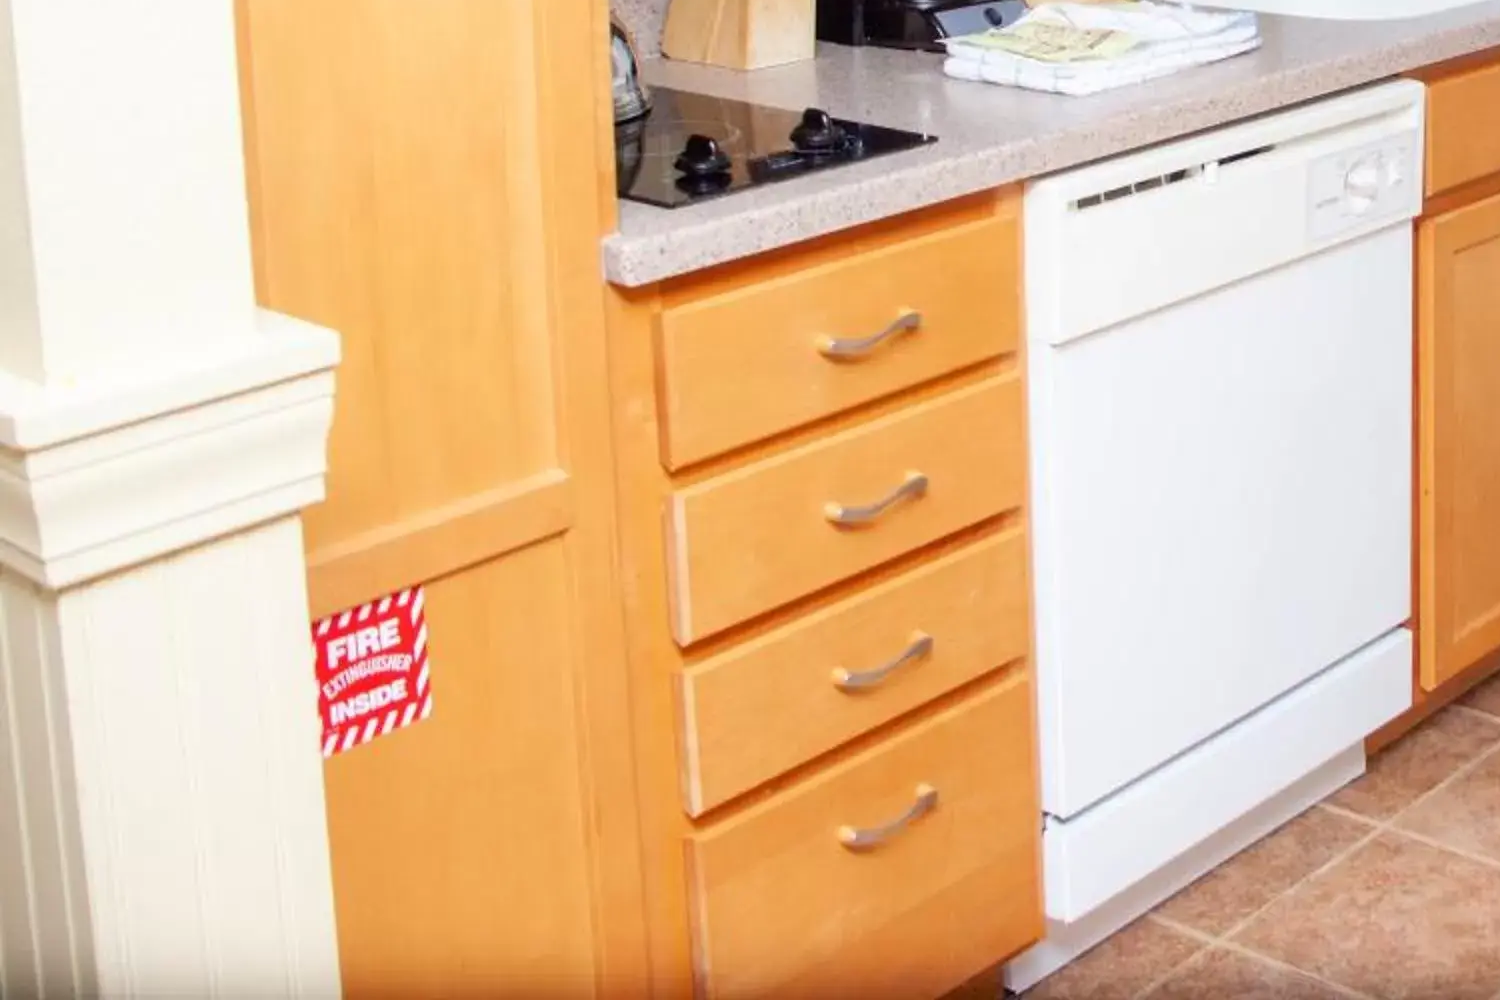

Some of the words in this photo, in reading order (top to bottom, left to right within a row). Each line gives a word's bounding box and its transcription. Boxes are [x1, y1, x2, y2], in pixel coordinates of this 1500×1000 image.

[326, 617, 401, 670] FIRE
[322, 653, 413, 701] EXTINGUISHER
[329, 677, 408, 727] INSIDE
